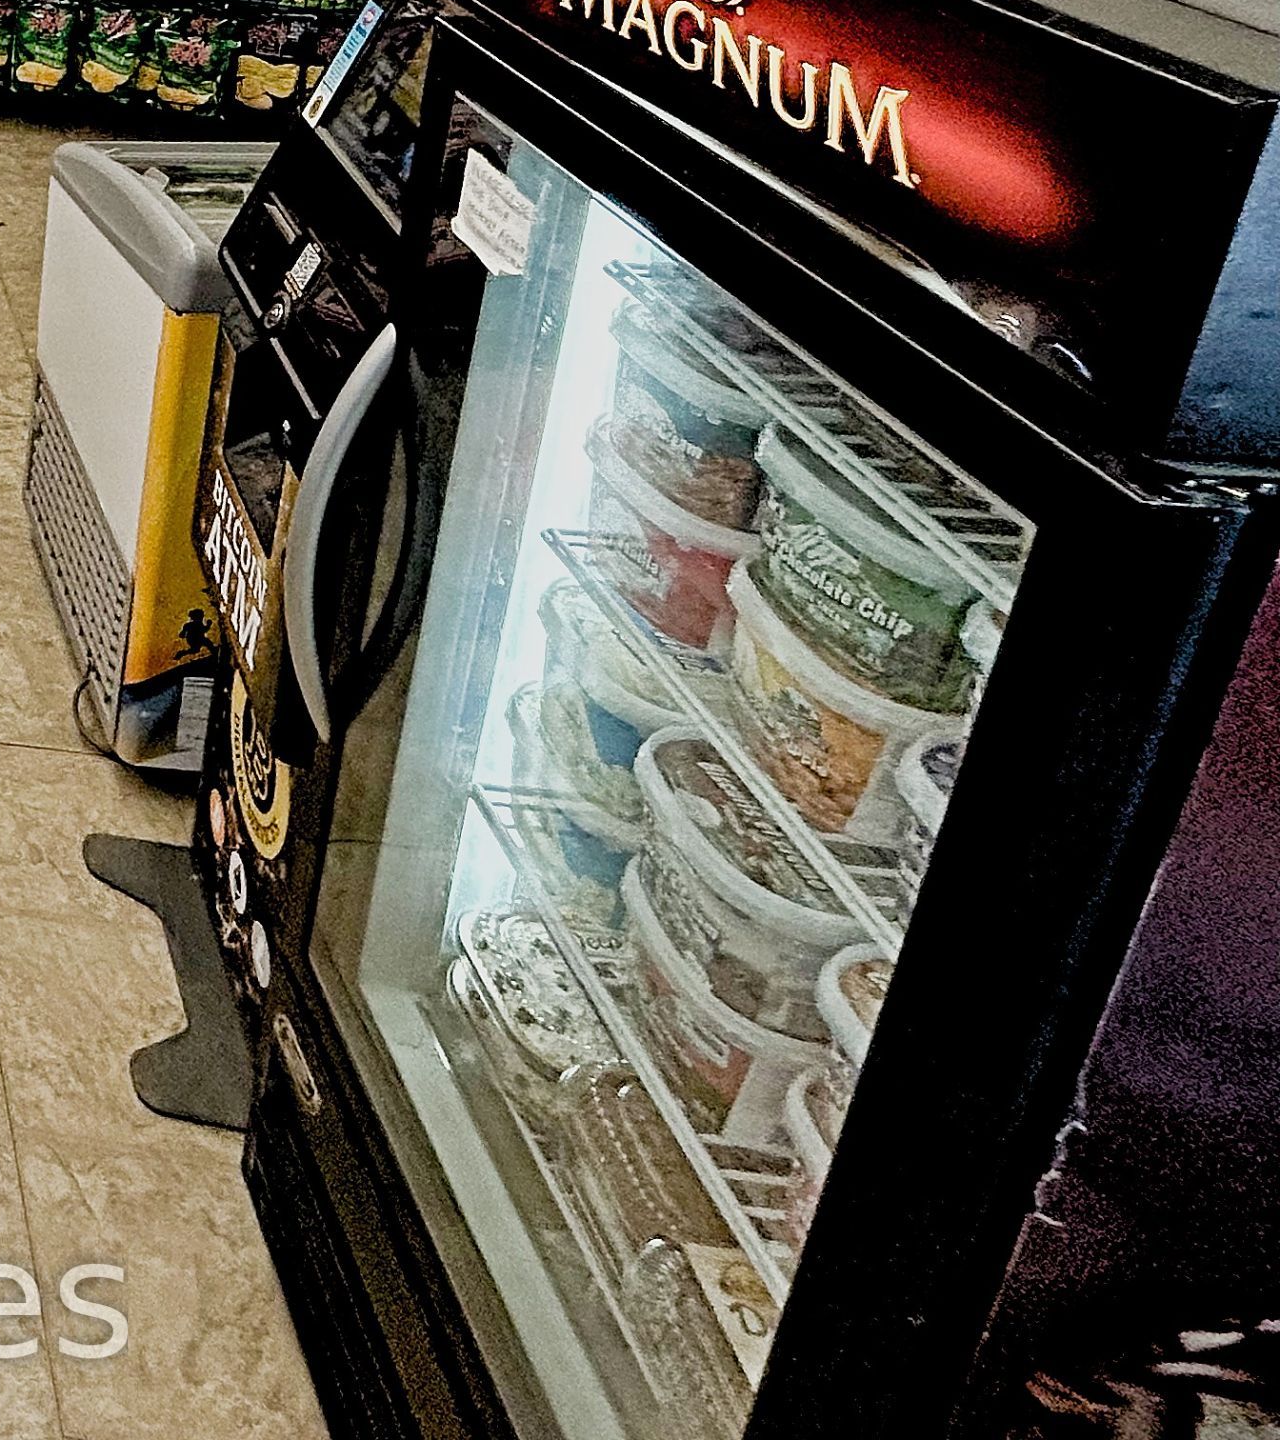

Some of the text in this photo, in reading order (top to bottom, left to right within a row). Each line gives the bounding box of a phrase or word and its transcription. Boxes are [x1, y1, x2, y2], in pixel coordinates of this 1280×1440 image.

[204, 511, 262, 672] ATM
[213, 468, 268, 613] BITCOIN
[858, 595, 914, 641] Chip
